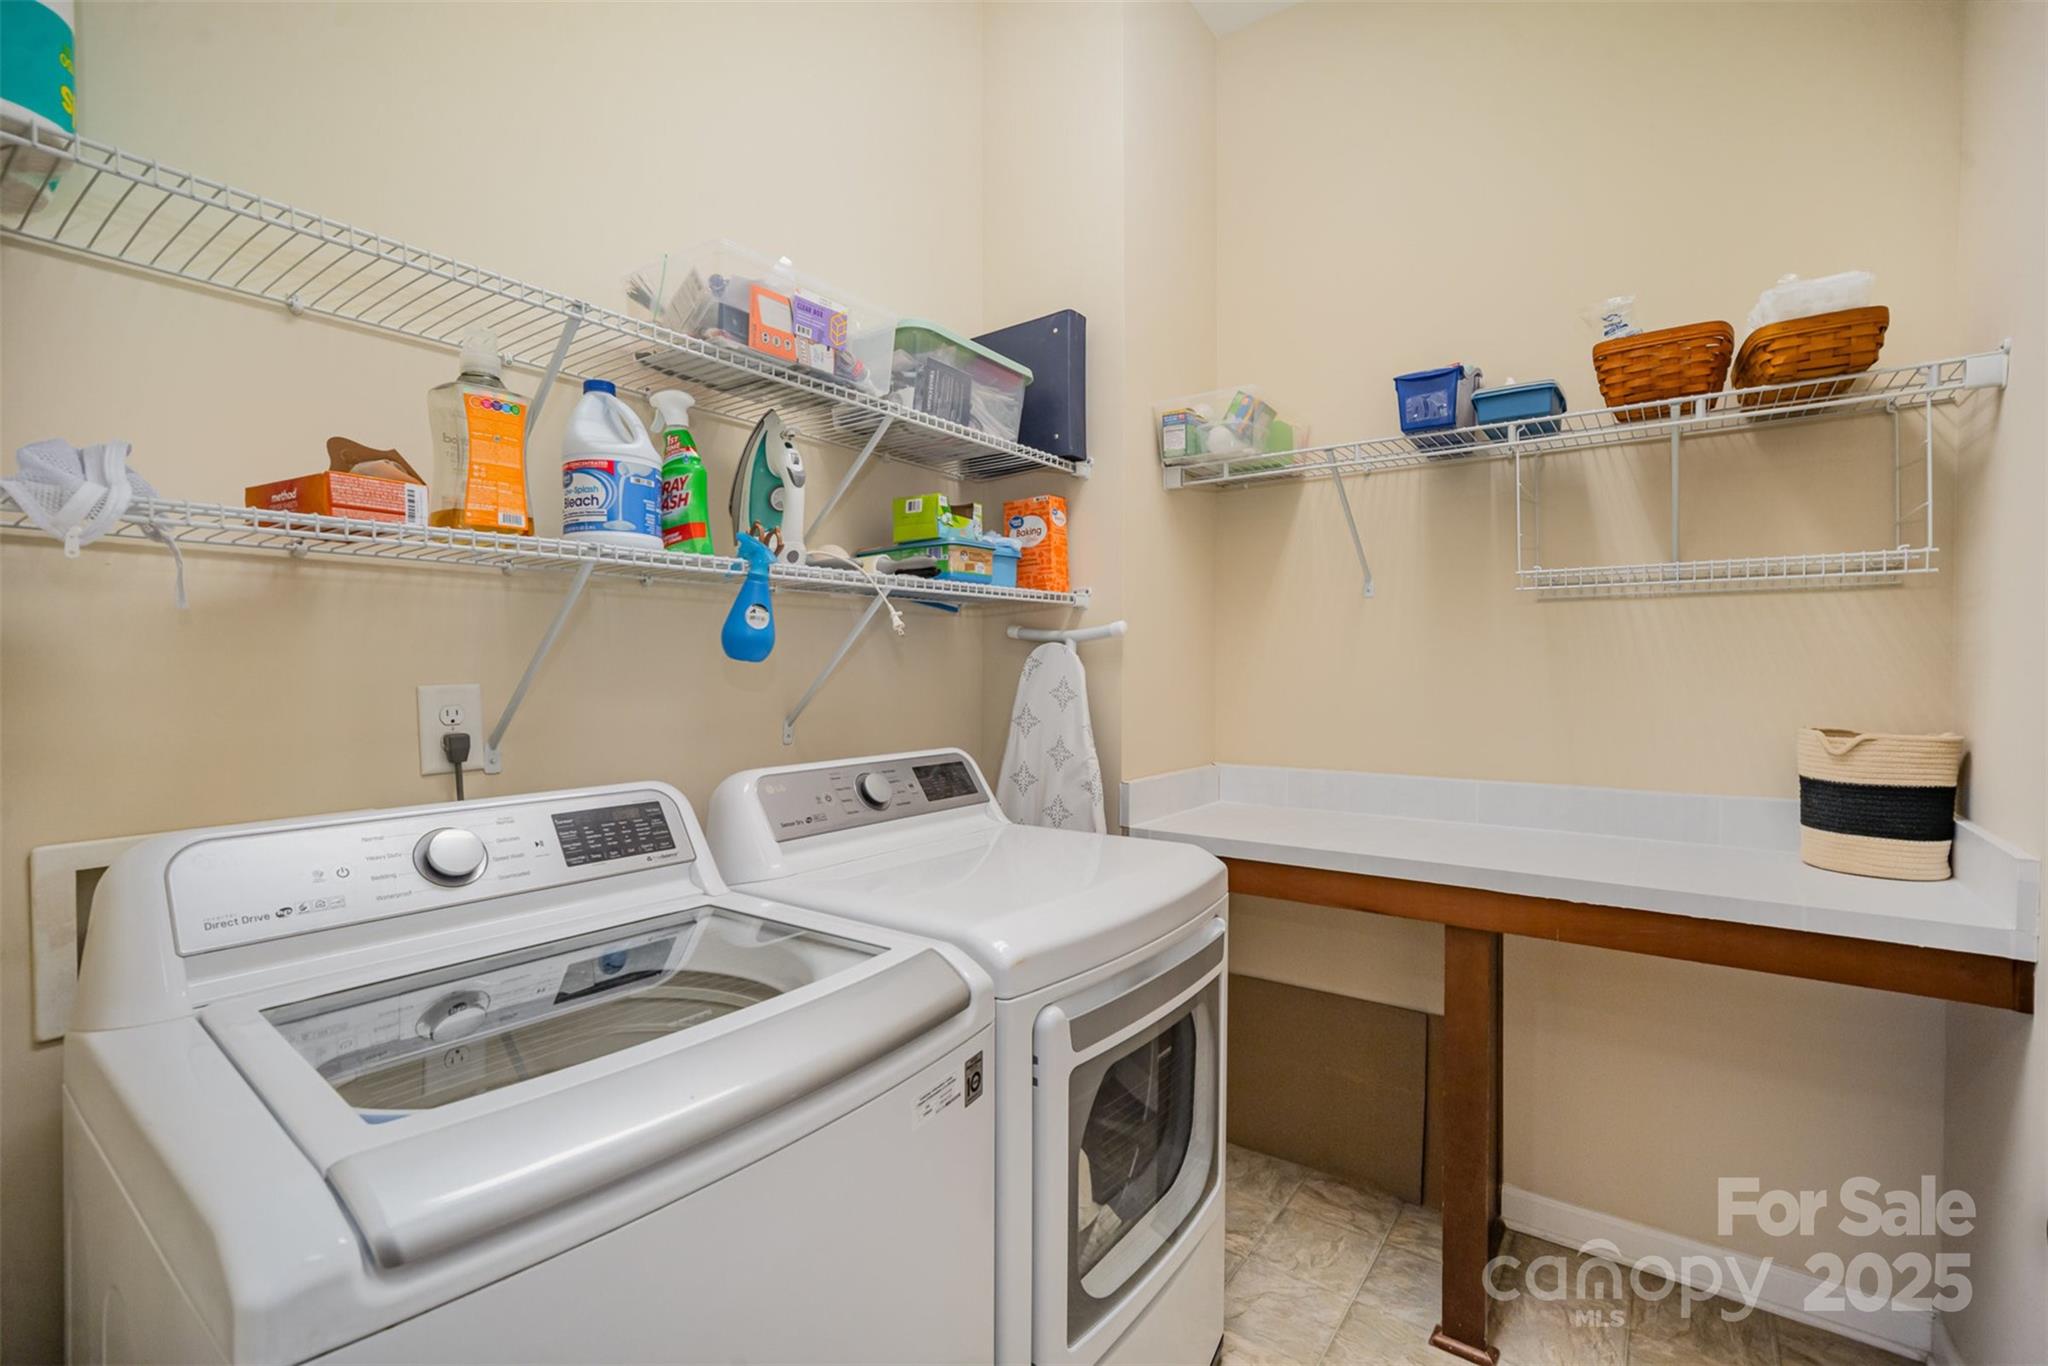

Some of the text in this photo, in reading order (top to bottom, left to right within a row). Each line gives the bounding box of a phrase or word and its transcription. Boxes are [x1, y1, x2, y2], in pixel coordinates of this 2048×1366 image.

[662, 475, 689, 495] RAY
[662, 492, 690, 511] ASH
[1016, 527, 1042, 538] Baking
[204, 918, 239, 931] Direct
[241, 912, 271, 925] Drive
